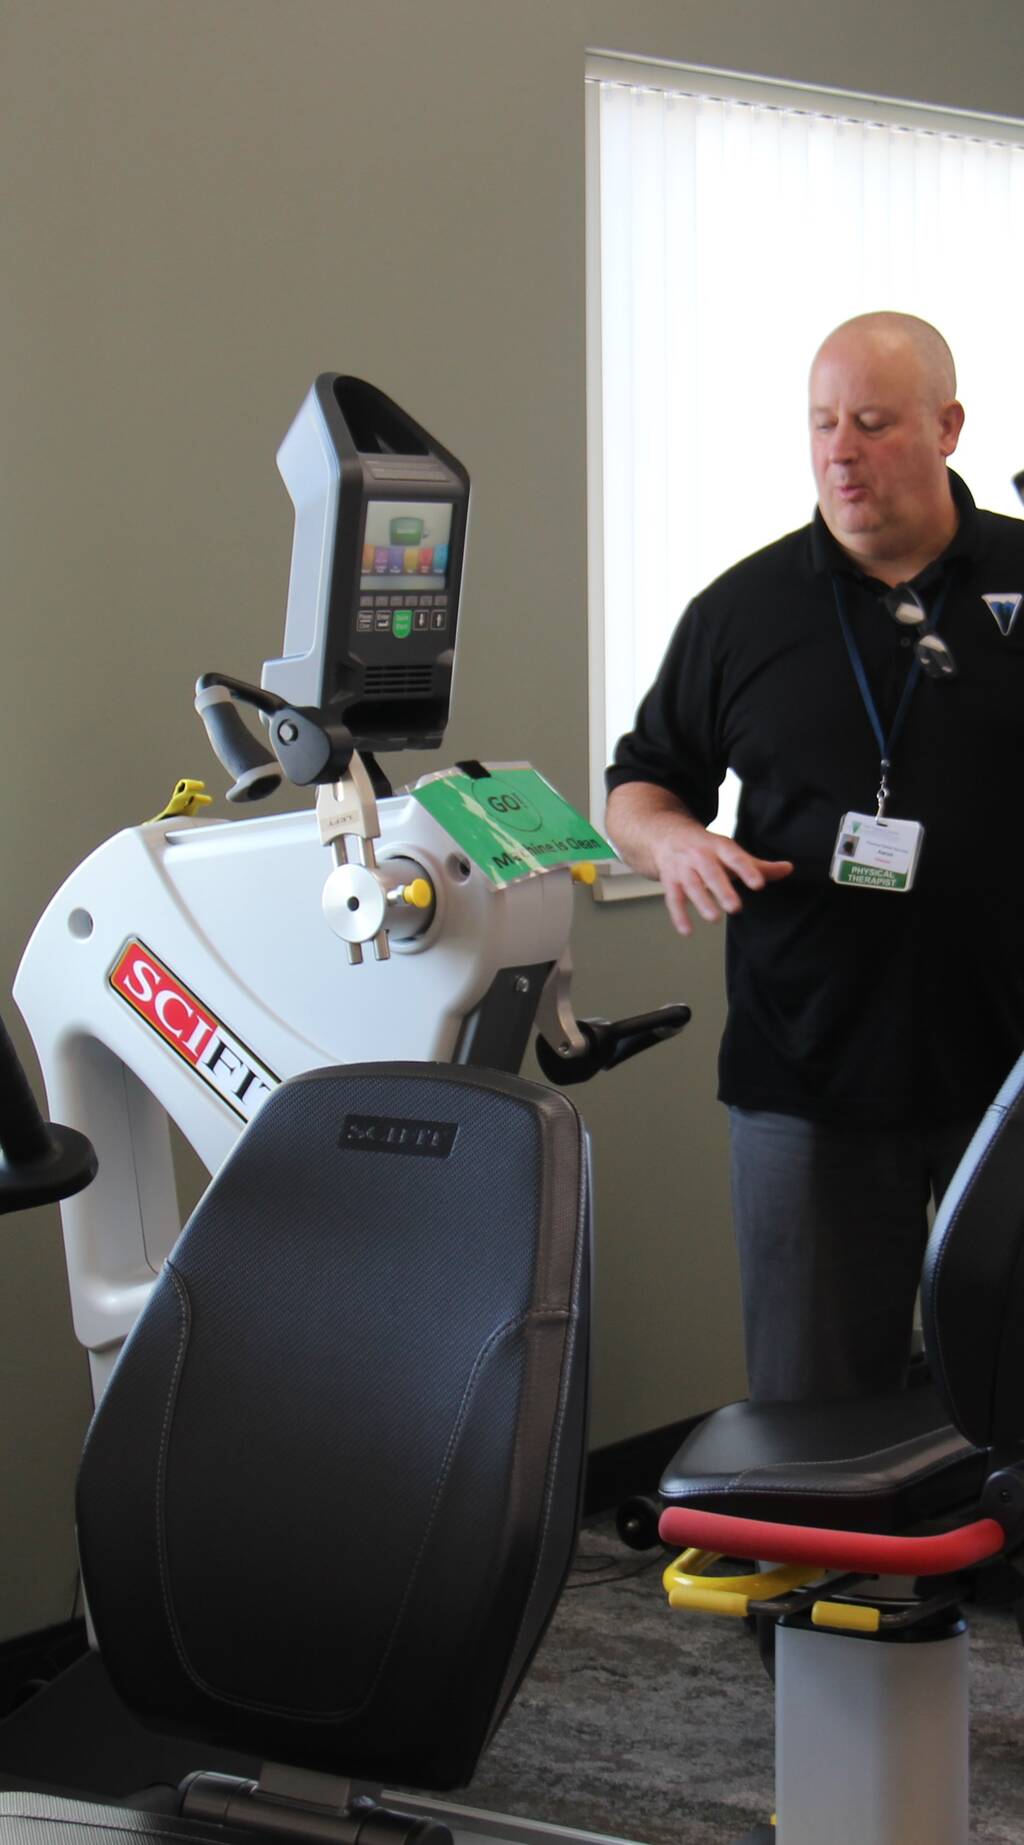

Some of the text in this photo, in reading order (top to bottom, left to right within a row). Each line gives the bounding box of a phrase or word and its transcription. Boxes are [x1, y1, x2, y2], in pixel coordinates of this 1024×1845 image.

[487, 792, 528, 813] GO!
[492, 843, 558, 869] Mhine
[848, 873, 896, 887] THERAPIST
[851, 866, 896, 880] PHYSICAL
[123, 959, 272, 1106] SCIFI
